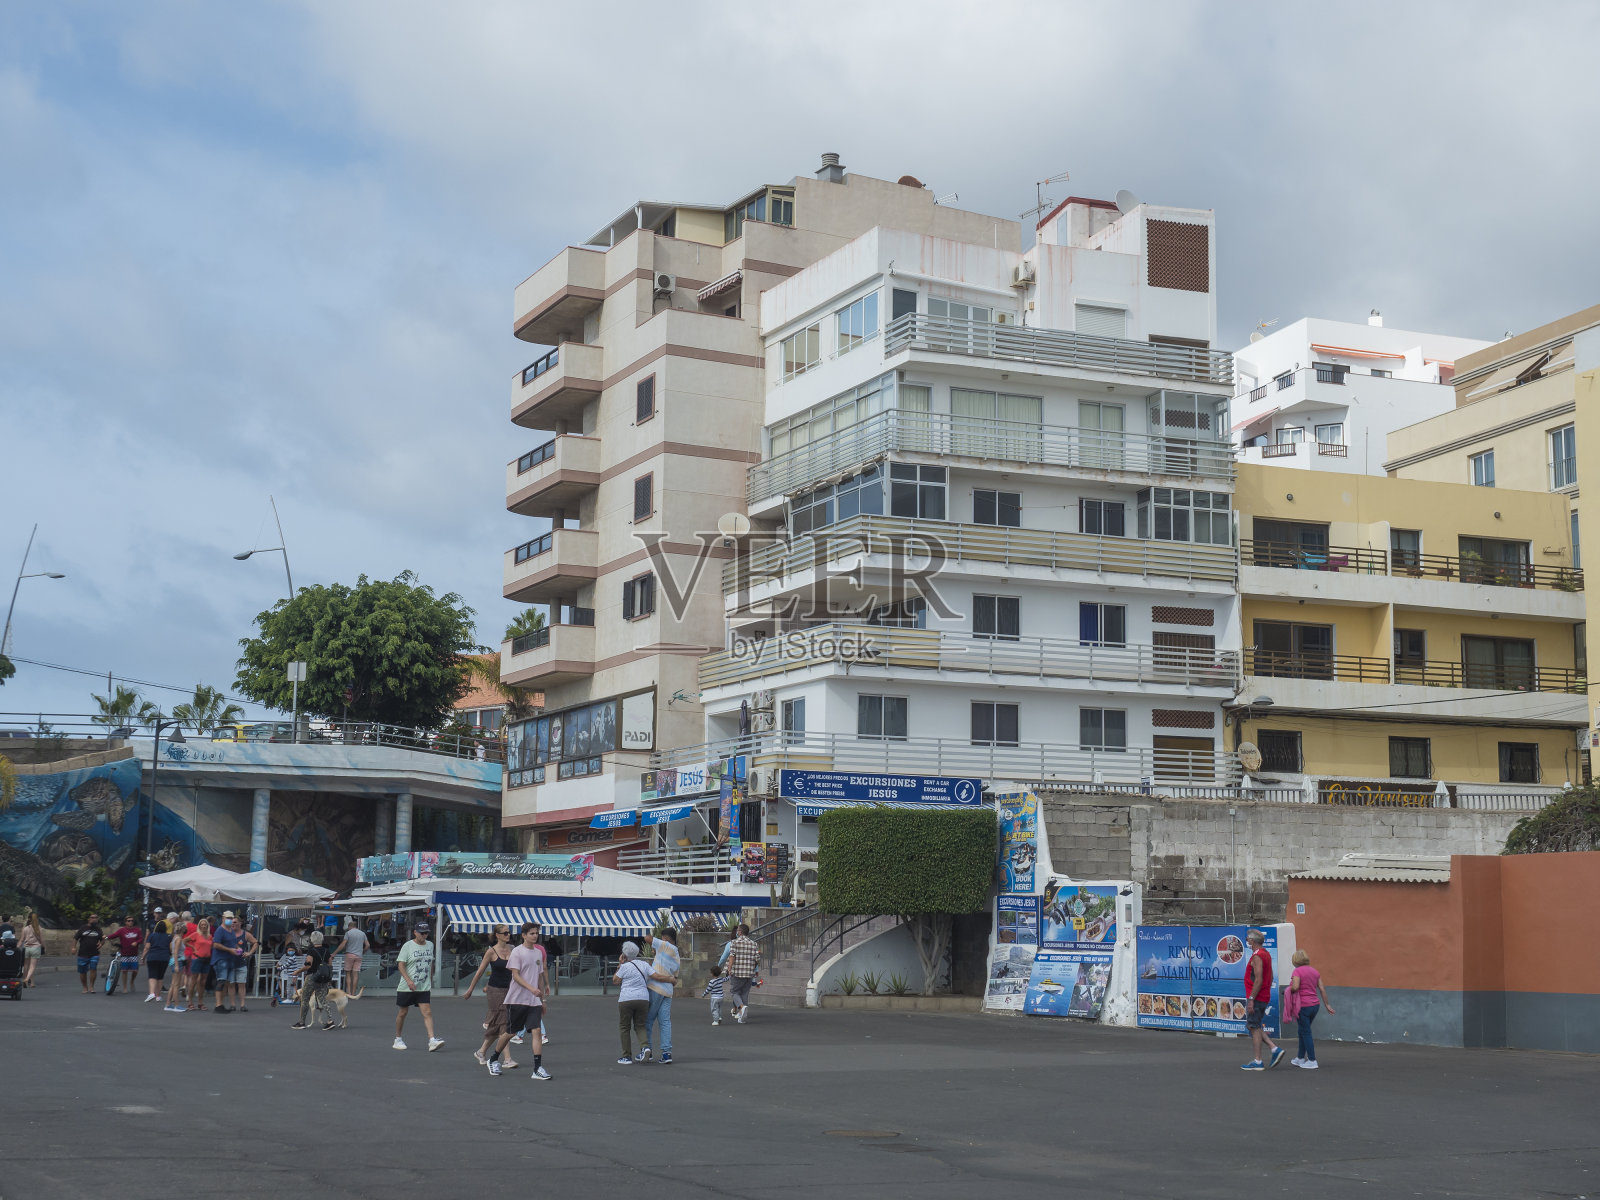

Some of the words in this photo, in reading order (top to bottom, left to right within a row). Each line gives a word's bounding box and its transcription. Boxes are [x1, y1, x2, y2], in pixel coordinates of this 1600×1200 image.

[624, 730, 651, 743] PADI
[849, 776, 917, 788] EXCURSIONES
[868, 787, 898, 799] JESÚS
[600, 812, 630, 822] EXCURSIONES
[461, 862, 499, 874] Rincón
[501, 863, 516, 874] del
[1015, 875, 1032, 883] BOOK
[1000, 897, 1024, 907] EXCURSIONES
[1168, 942, 1211, 960] RINCÓN
[1161, 966, 1220, 981] MARINERO
